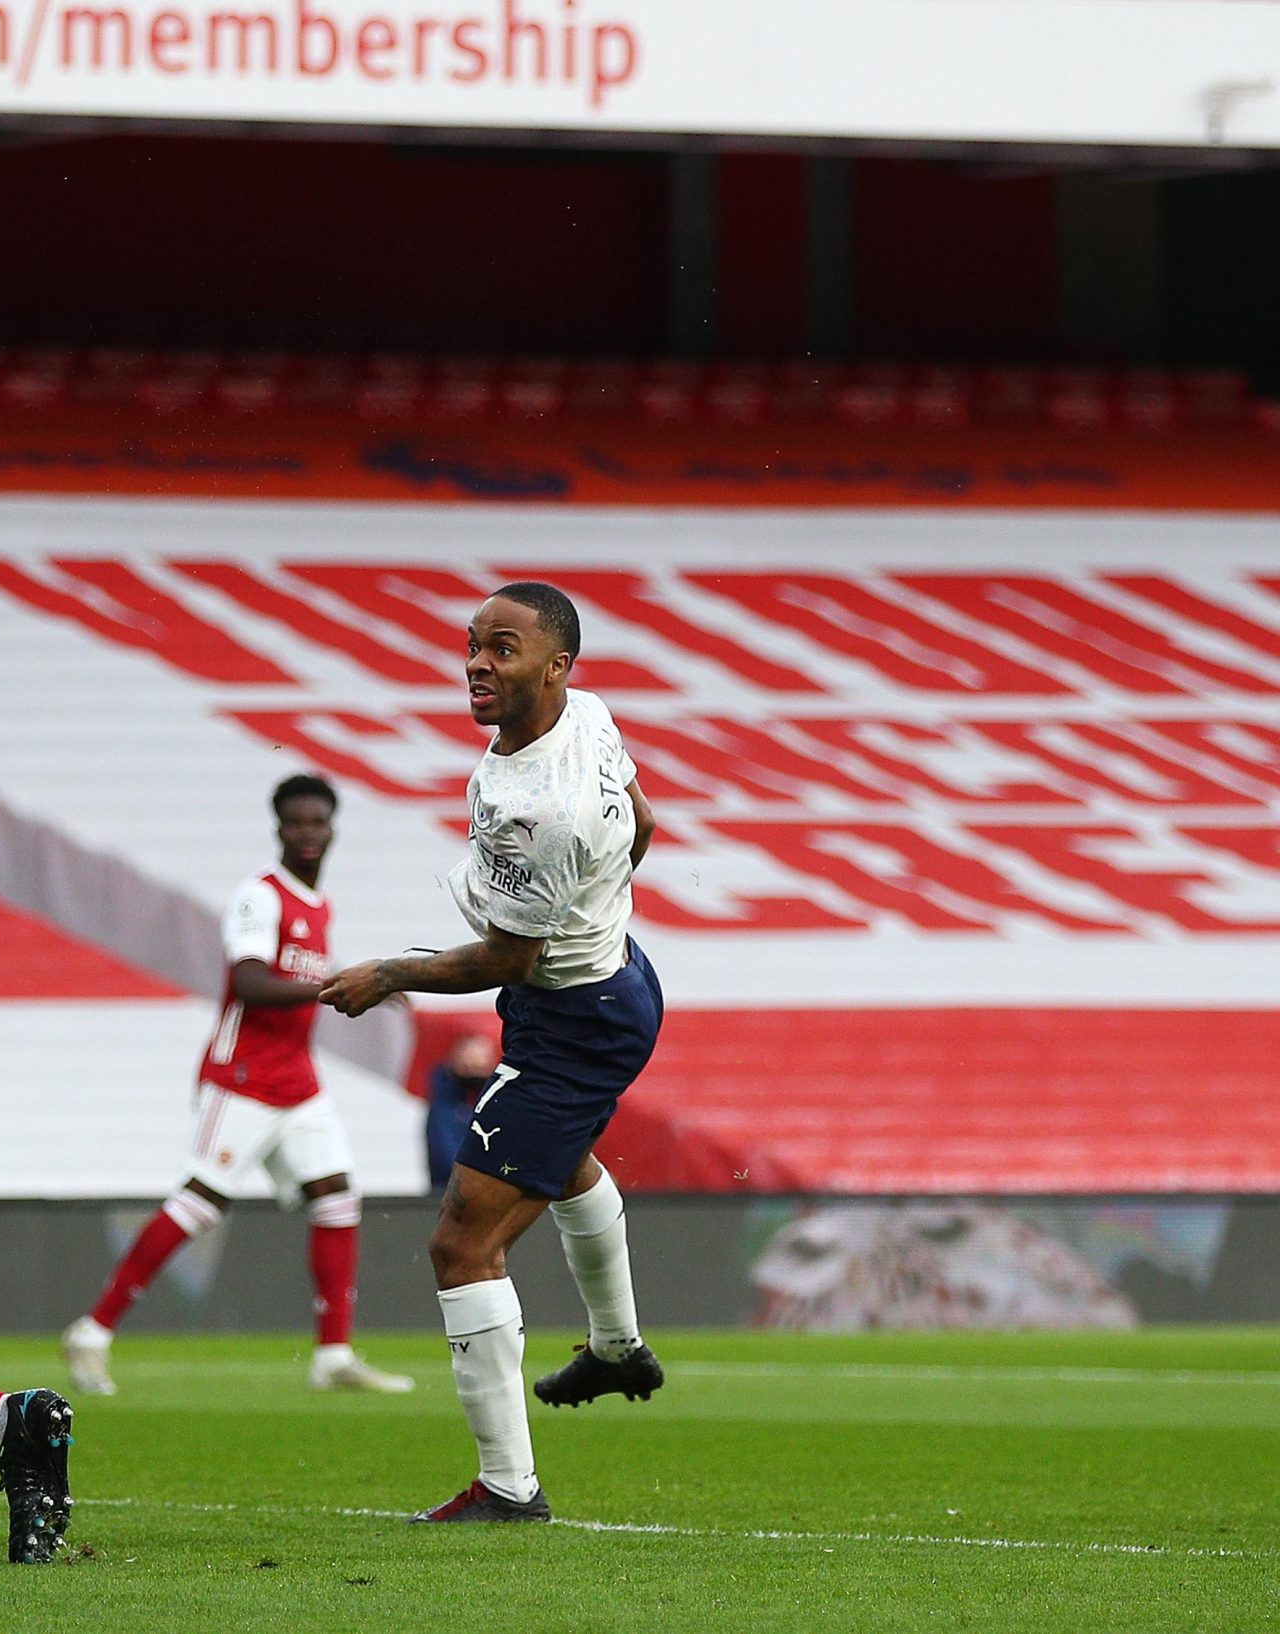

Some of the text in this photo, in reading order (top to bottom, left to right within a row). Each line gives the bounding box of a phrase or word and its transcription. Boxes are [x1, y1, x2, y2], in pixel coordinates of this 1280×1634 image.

[490, 866, 524, 897] TIRE
[492, 853, 533, 885] EXEN
[474, 1062, 521, 1114] 7
[449, 1341, 470, 1353] TY
